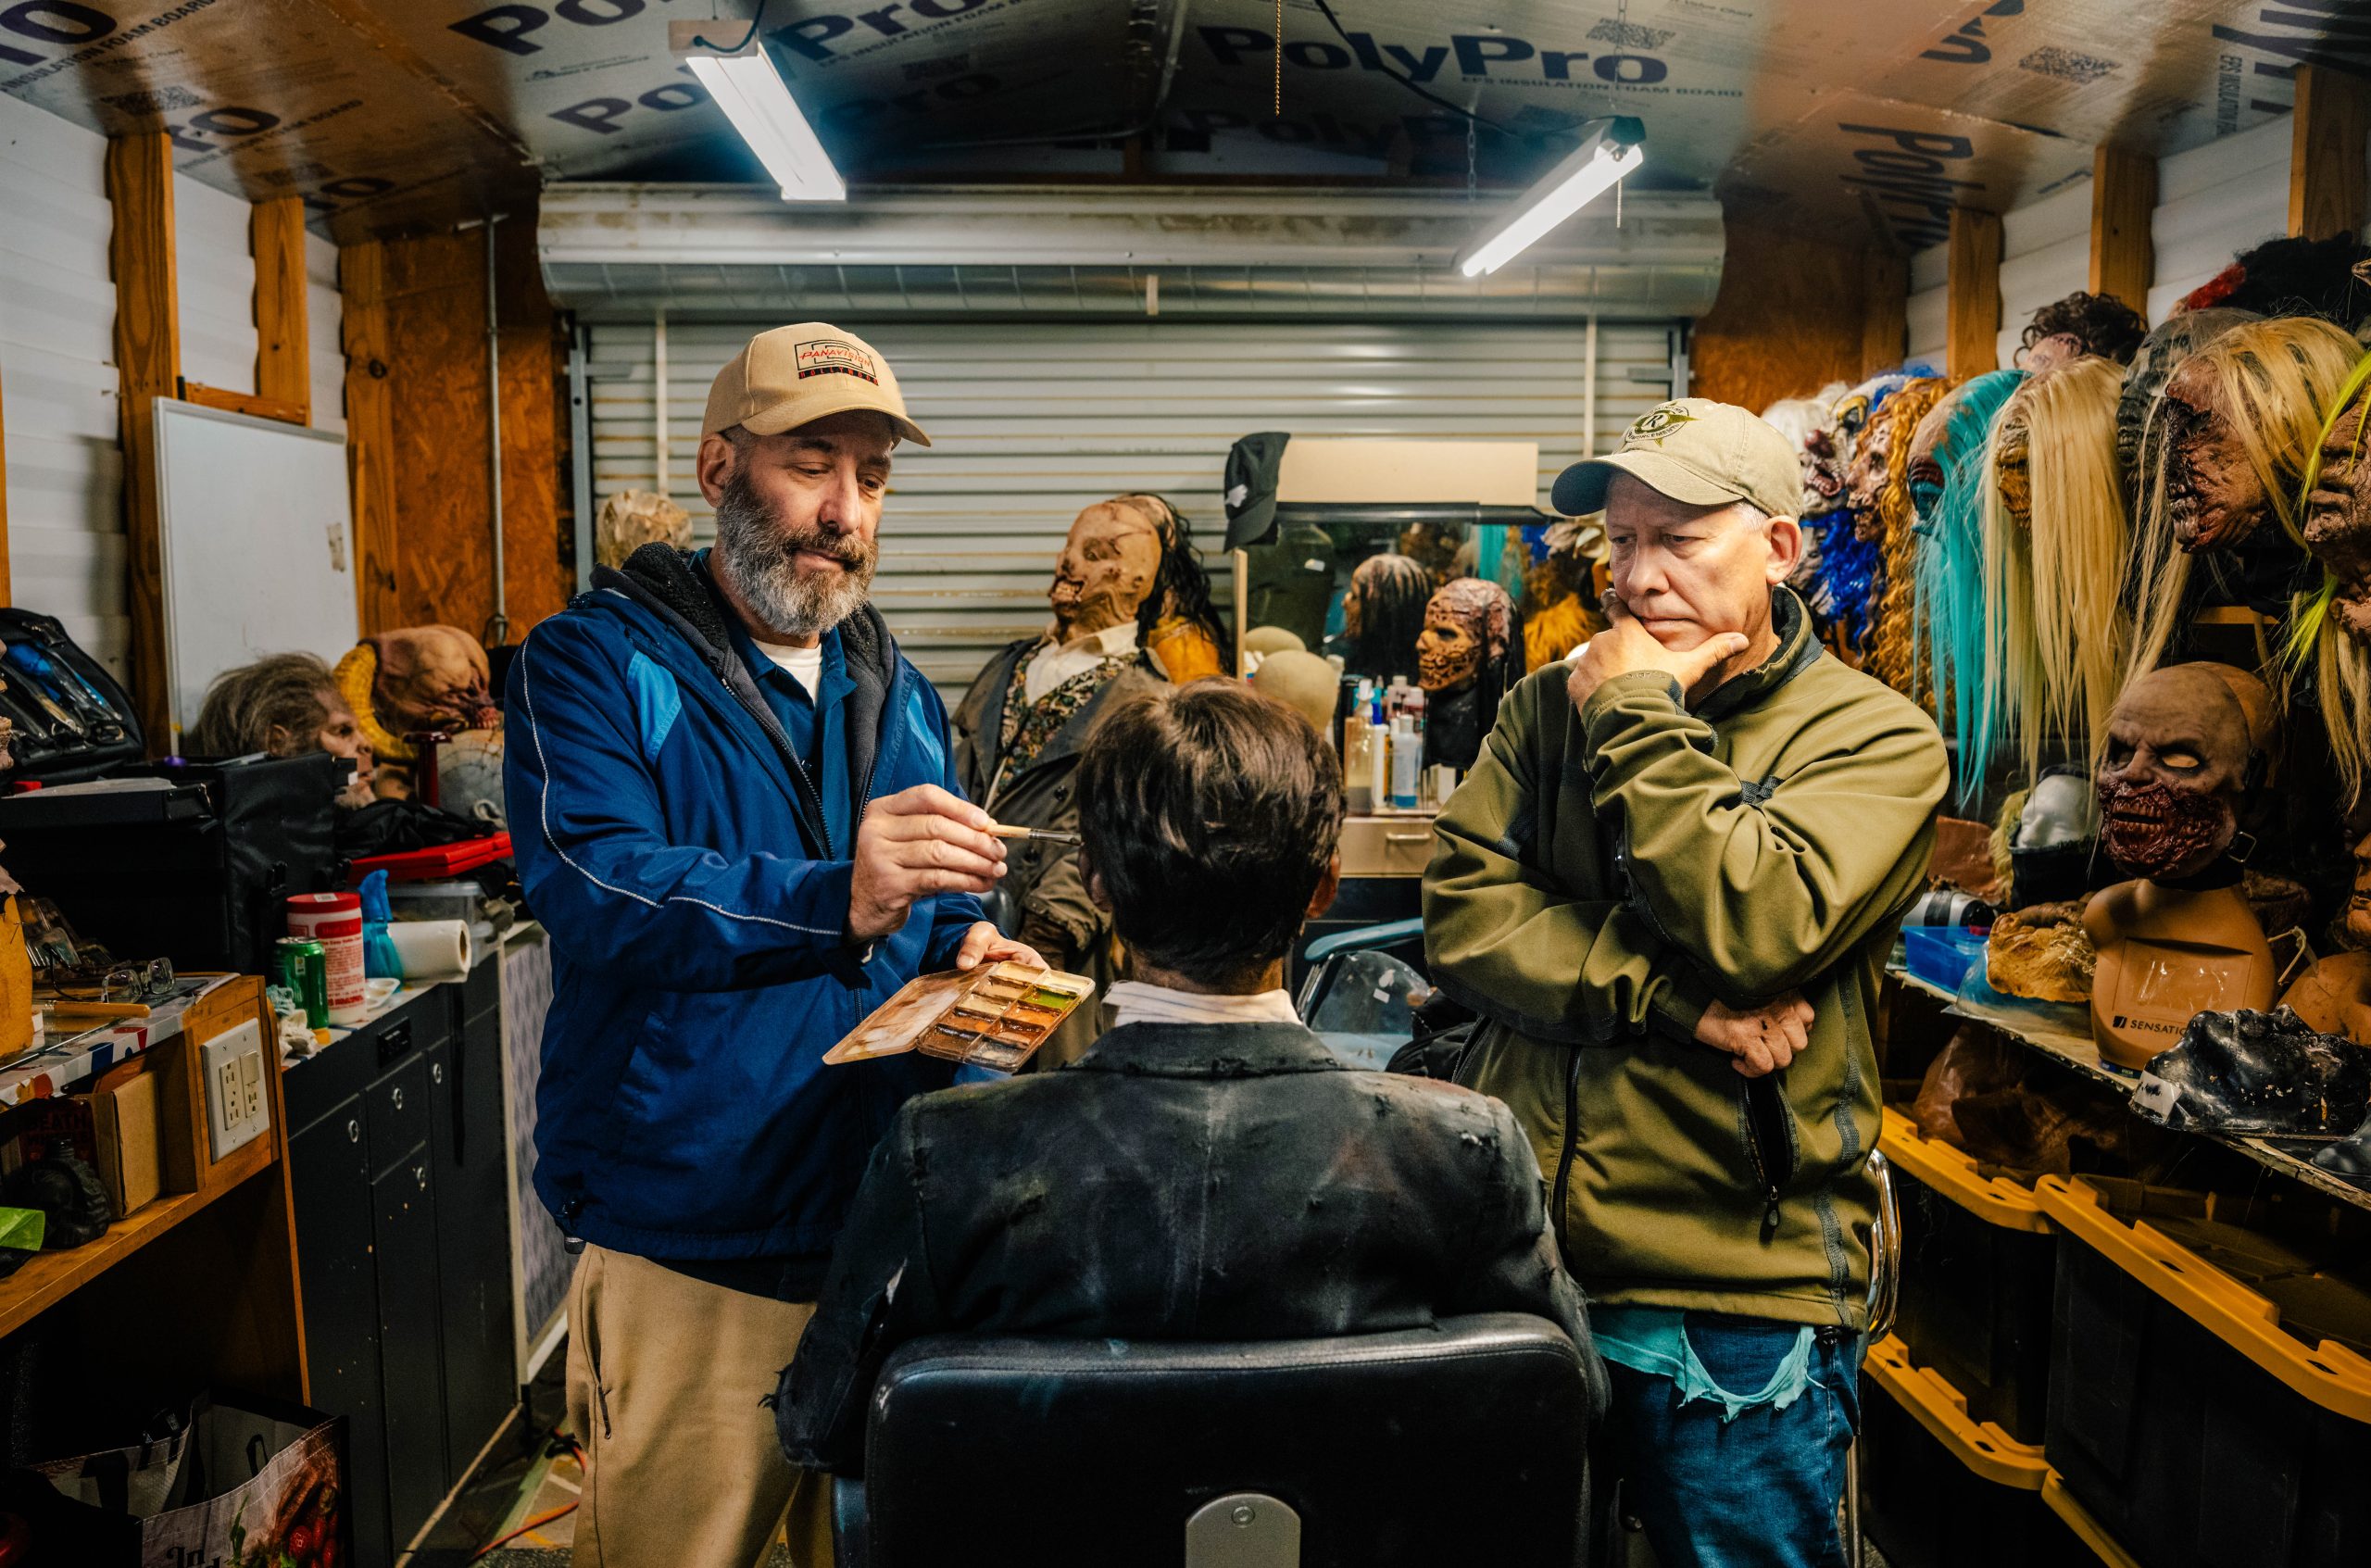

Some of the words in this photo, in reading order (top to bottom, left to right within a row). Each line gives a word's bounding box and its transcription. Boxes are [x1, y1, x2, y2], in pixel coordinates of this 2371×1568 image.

[99, 23, 156, 50] FOAM
[446, 0, 646, 56] Po
[1197, 23, 1668, 85] PolyPro
[1499, 77, 1611, 91] INSULATION
[800, 349, 871, 367] PANAVISION
[800, 367, 879, 385] HOLLYWOOD
